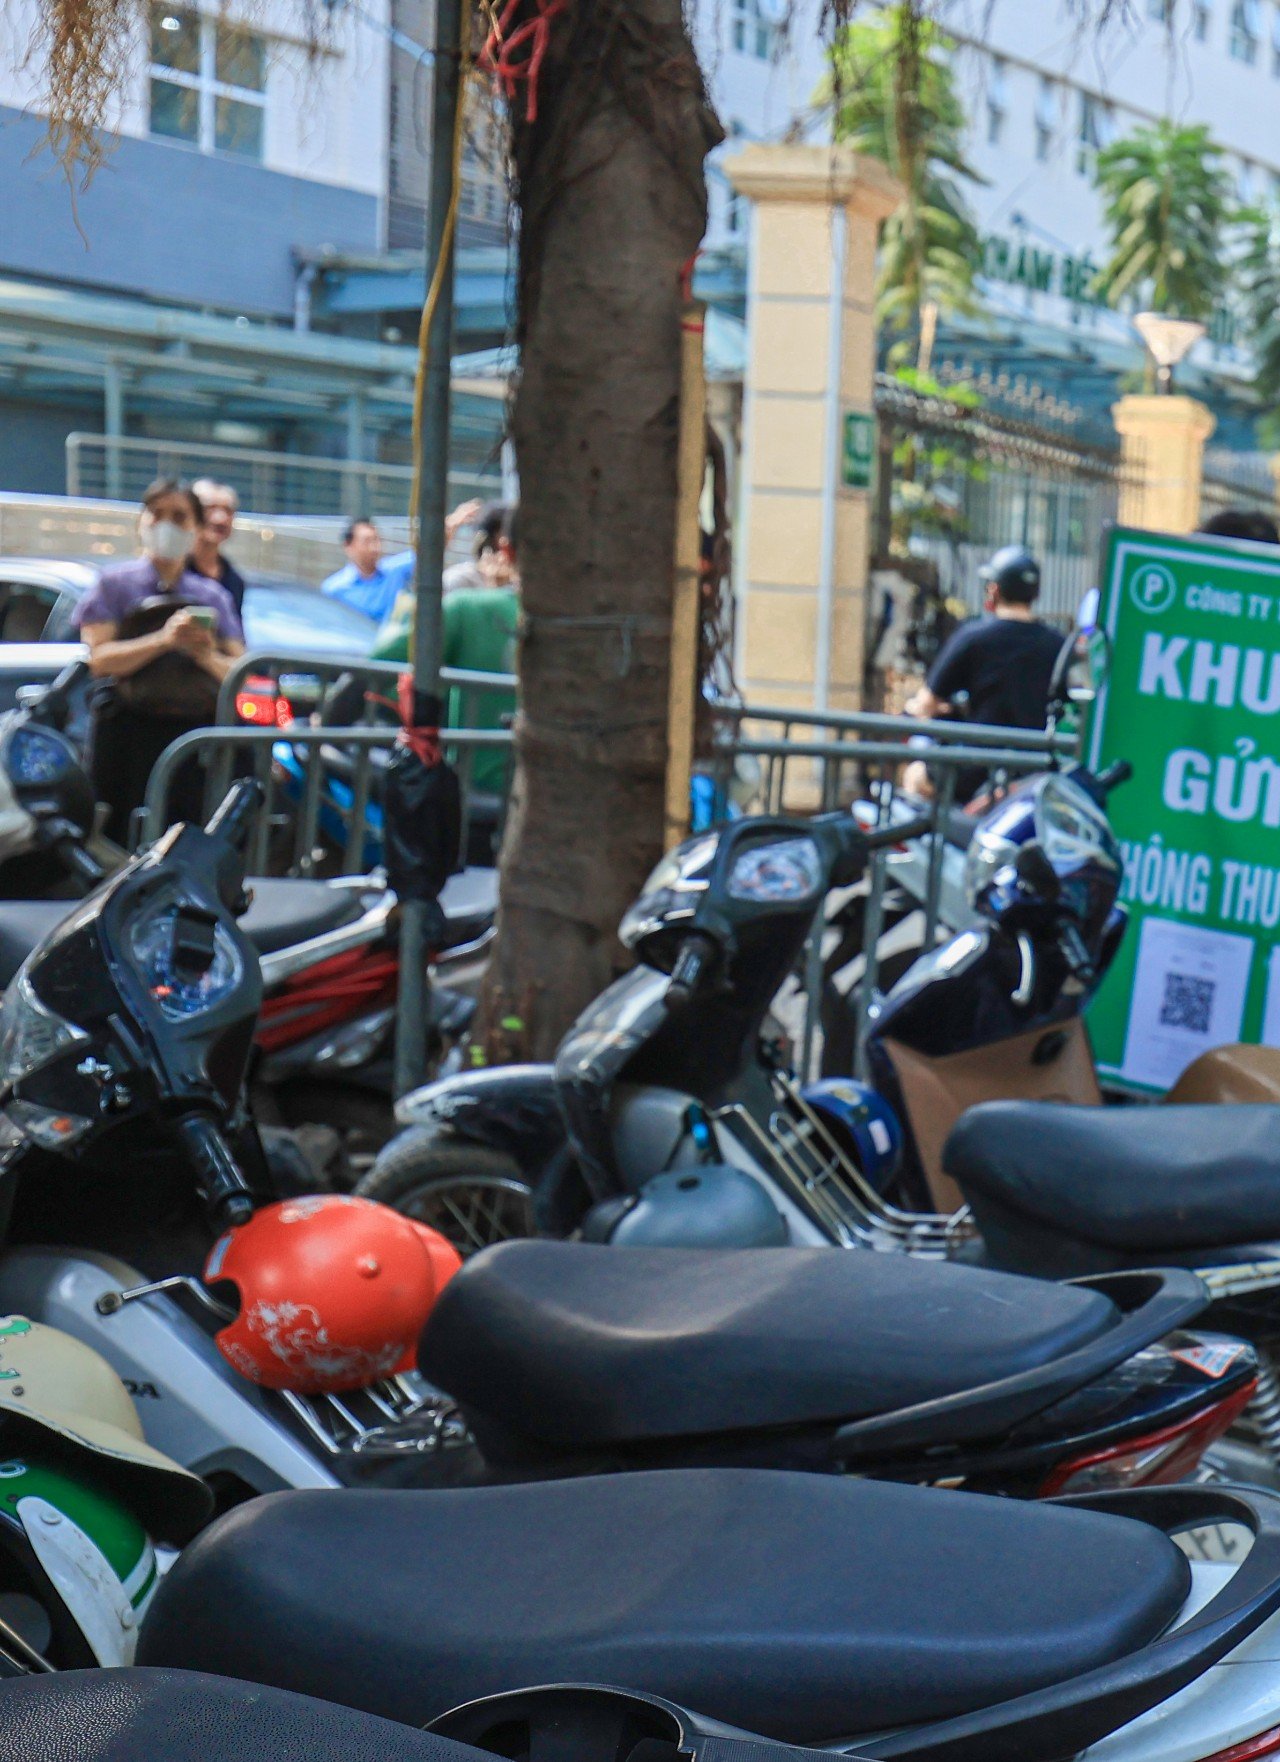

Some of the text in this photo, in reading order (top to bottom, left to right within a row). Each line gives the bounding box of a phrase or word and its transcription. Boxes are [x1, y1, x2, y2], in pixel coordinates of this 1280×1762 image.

[1185, 581, 1242, 617] CÔNG
[1248, 593, 1272, 621] TY
[1118, 833, 1211, 915] HÔNG
